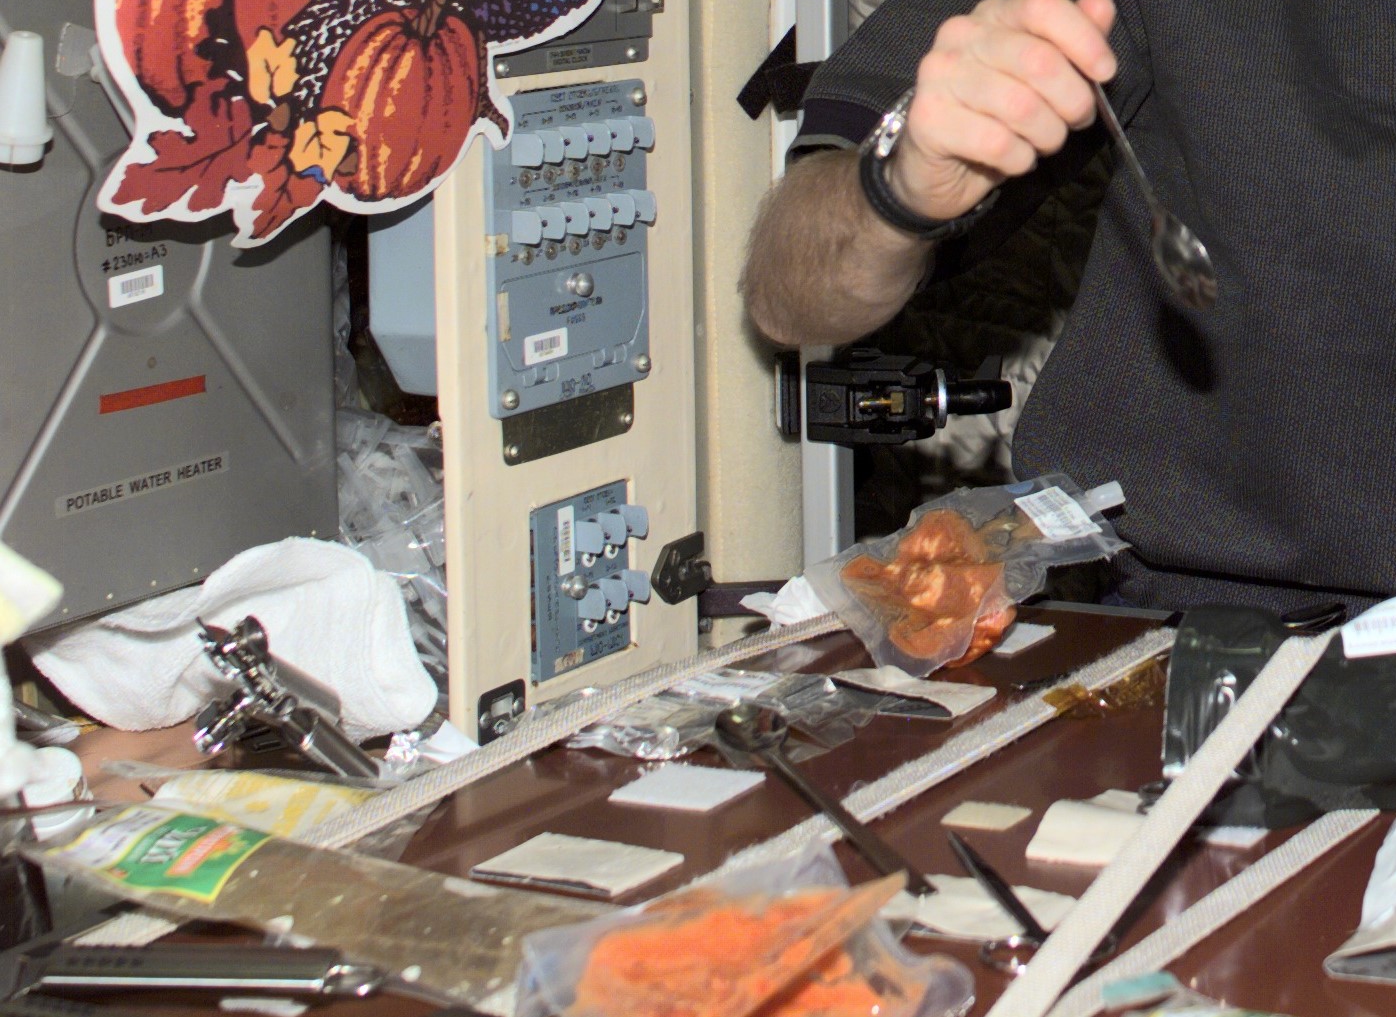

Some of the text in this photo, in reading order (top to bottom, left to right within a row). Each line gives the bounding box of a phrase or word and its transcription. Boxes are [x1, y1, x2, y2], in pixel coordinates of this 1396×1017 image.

[65, 456, 223, 512] POTABLE WATER HEATER
